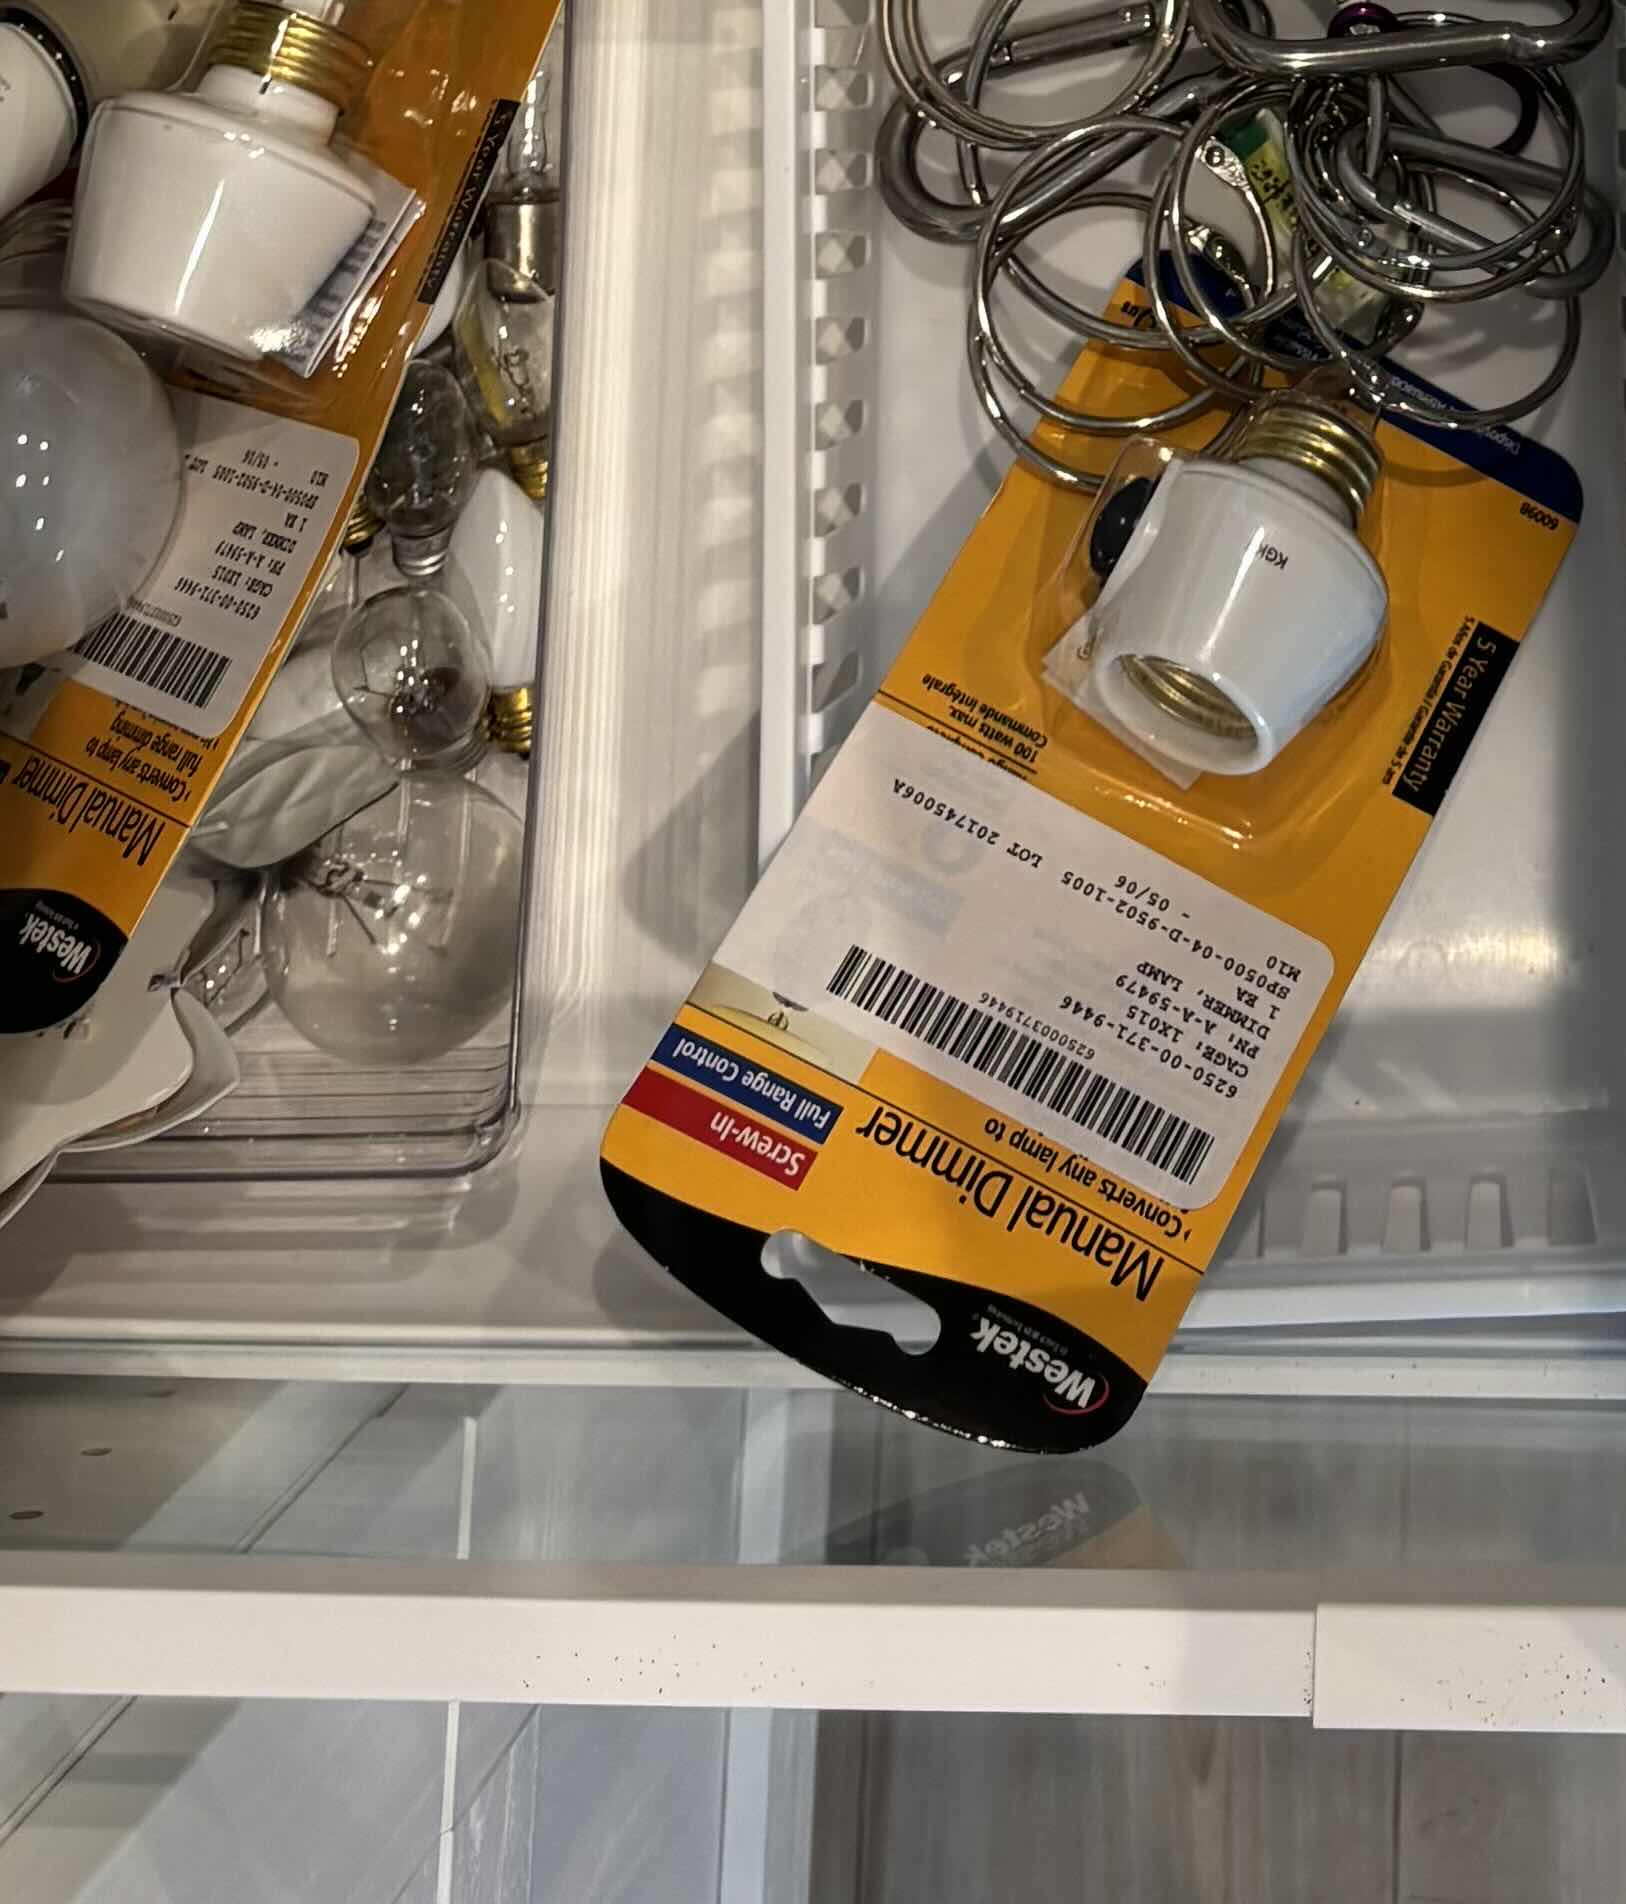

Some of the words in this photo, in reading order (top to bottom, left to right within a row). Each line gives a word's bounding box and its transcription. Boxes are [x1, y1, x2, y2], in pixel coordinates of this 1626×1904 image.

[1476, 636, 1496, 654] 5
[1453, 657, 1488, 699] Year
[85, 736, 100, 757] to
[109, 707, 153, 752] dimming
[978, 703, 1048, 749] Commande
[978, 722, 1014, 748] watts
[1402, 701, 1466, 792] Warranty
[95, 737, 124, 771] lamp
[116, 746, 142, 775] any
[149, 732, 183, 762] range
[175, 749, 203, 778] full
[1013, 742, 1038, 763] 100
[15, 755, 90, 826] Dimmer
[135, 762, 187, 802] Converts
[67, 786, 166, 867] Manual
[893, 778, 1000, 845] 201745006A
[1006, 842, 1043, 868] LOT
[1114, 875, 1170, 912] 05/06
[19, 913, 92, 976] Westek
[1061, 871, 1291, 1000] SP0500-04-D-9502-1005
[1136, 961, 1183, 992] LAMP
[1266, 955, 1301, 983] M10
[1115, 974, 1217, 1035] A-A-59479
[1196, 989, 1271, 1040] DIMMER,
[1236, 986, 1259, 1008] EA
[1268, 1004, 1280, 1020] 1
[978, 992, 1095, 1060] 6250003719446
[1125, 1005, 1184, 1043] 1X015
[672, 1038, 739, 1082] Control
[1059, 995, 1238, 1098] 6250-00-371-9446
[1195, 1040, 1249, 1078] CAGE:
[1227, 1032, 1260, 1059] PN:
[741, 1070, 797, 1112] Range
[793, 1098, 831, 1129] Full
[984, 1118, 1006, 1142] to
[710, 1111, 806, 1176] Screw-In
[855, 1106, 1013, 1218] Dimmer
[1008, 1130, 1059, 1173] lamp
[1057, 1154, 1097, 1187] any
[1097, 1178, 1182, 1238] Converts
[1006, 1185, 1166, 1302] Manual
[970, 1317, 1096, 1411] Westek
